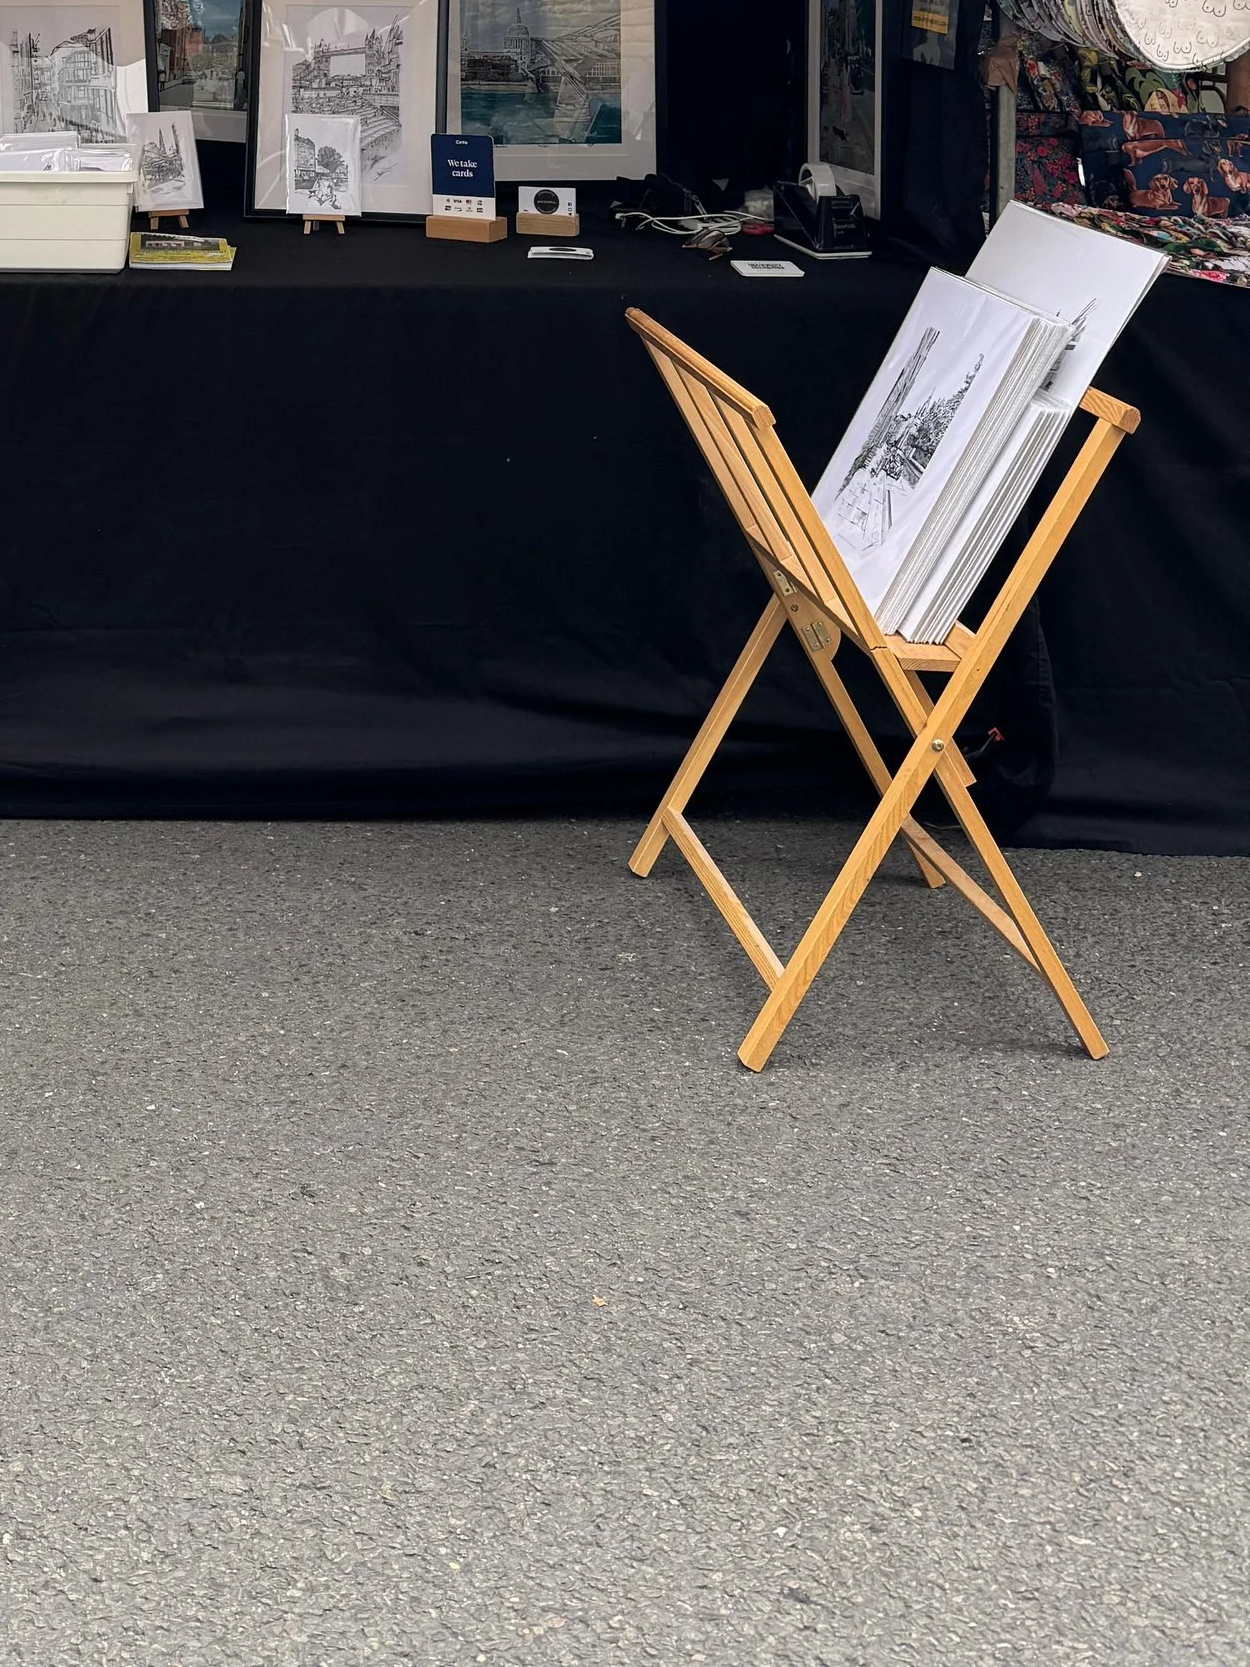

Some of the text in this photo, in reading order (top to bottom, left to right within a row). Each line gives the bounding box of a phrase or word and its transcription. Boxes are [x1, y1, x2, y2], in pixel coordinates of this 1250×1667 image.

[447, 159, 478, 168] We take
[451, 169, 474, 178] cards
